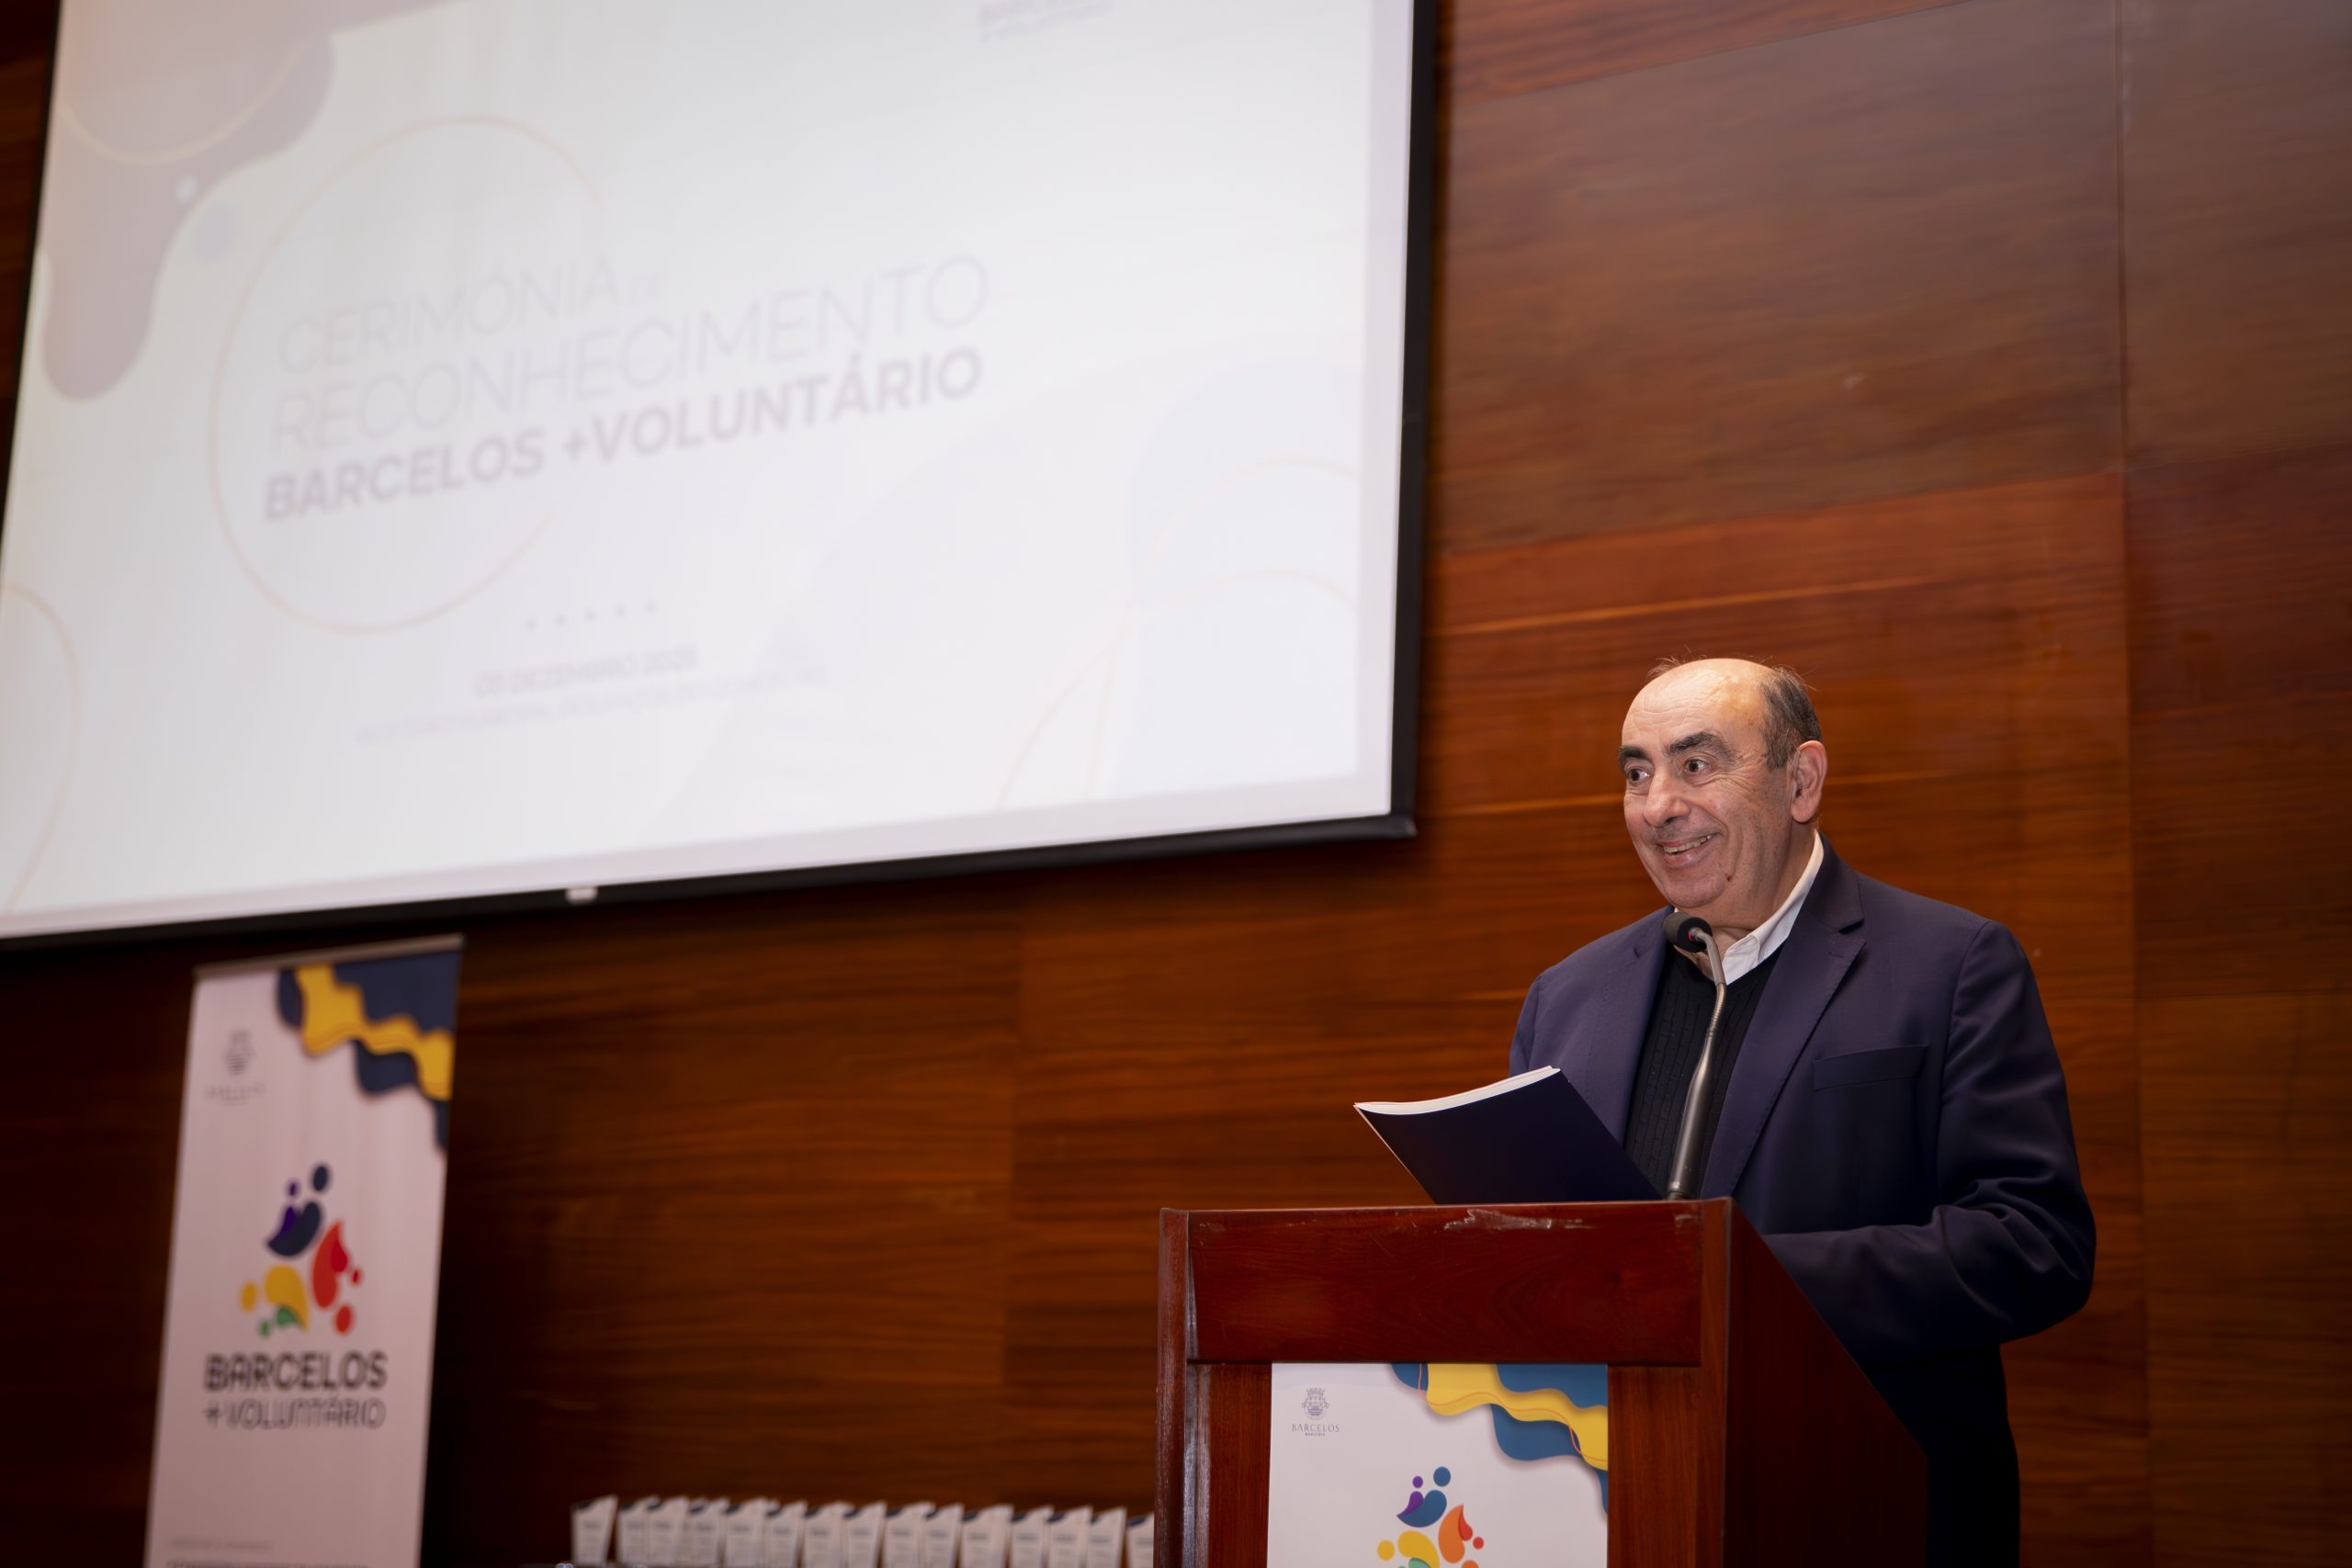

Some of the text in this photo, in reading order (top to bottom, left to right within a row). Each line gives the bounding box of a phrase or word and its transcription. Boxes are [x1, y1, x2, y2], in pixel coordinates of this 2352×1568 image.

[273, 253, 990, 453] RECONHECIMENTO
[278, 253, 621, 376] CERIMÓNIA
[263, 345, 983, 523] BARCELOS +VOLUNTÁRIO
[204, 1349, 388, 1392] BARCELOS
[1292, 1423, 1340, 1433] BARCELOS
